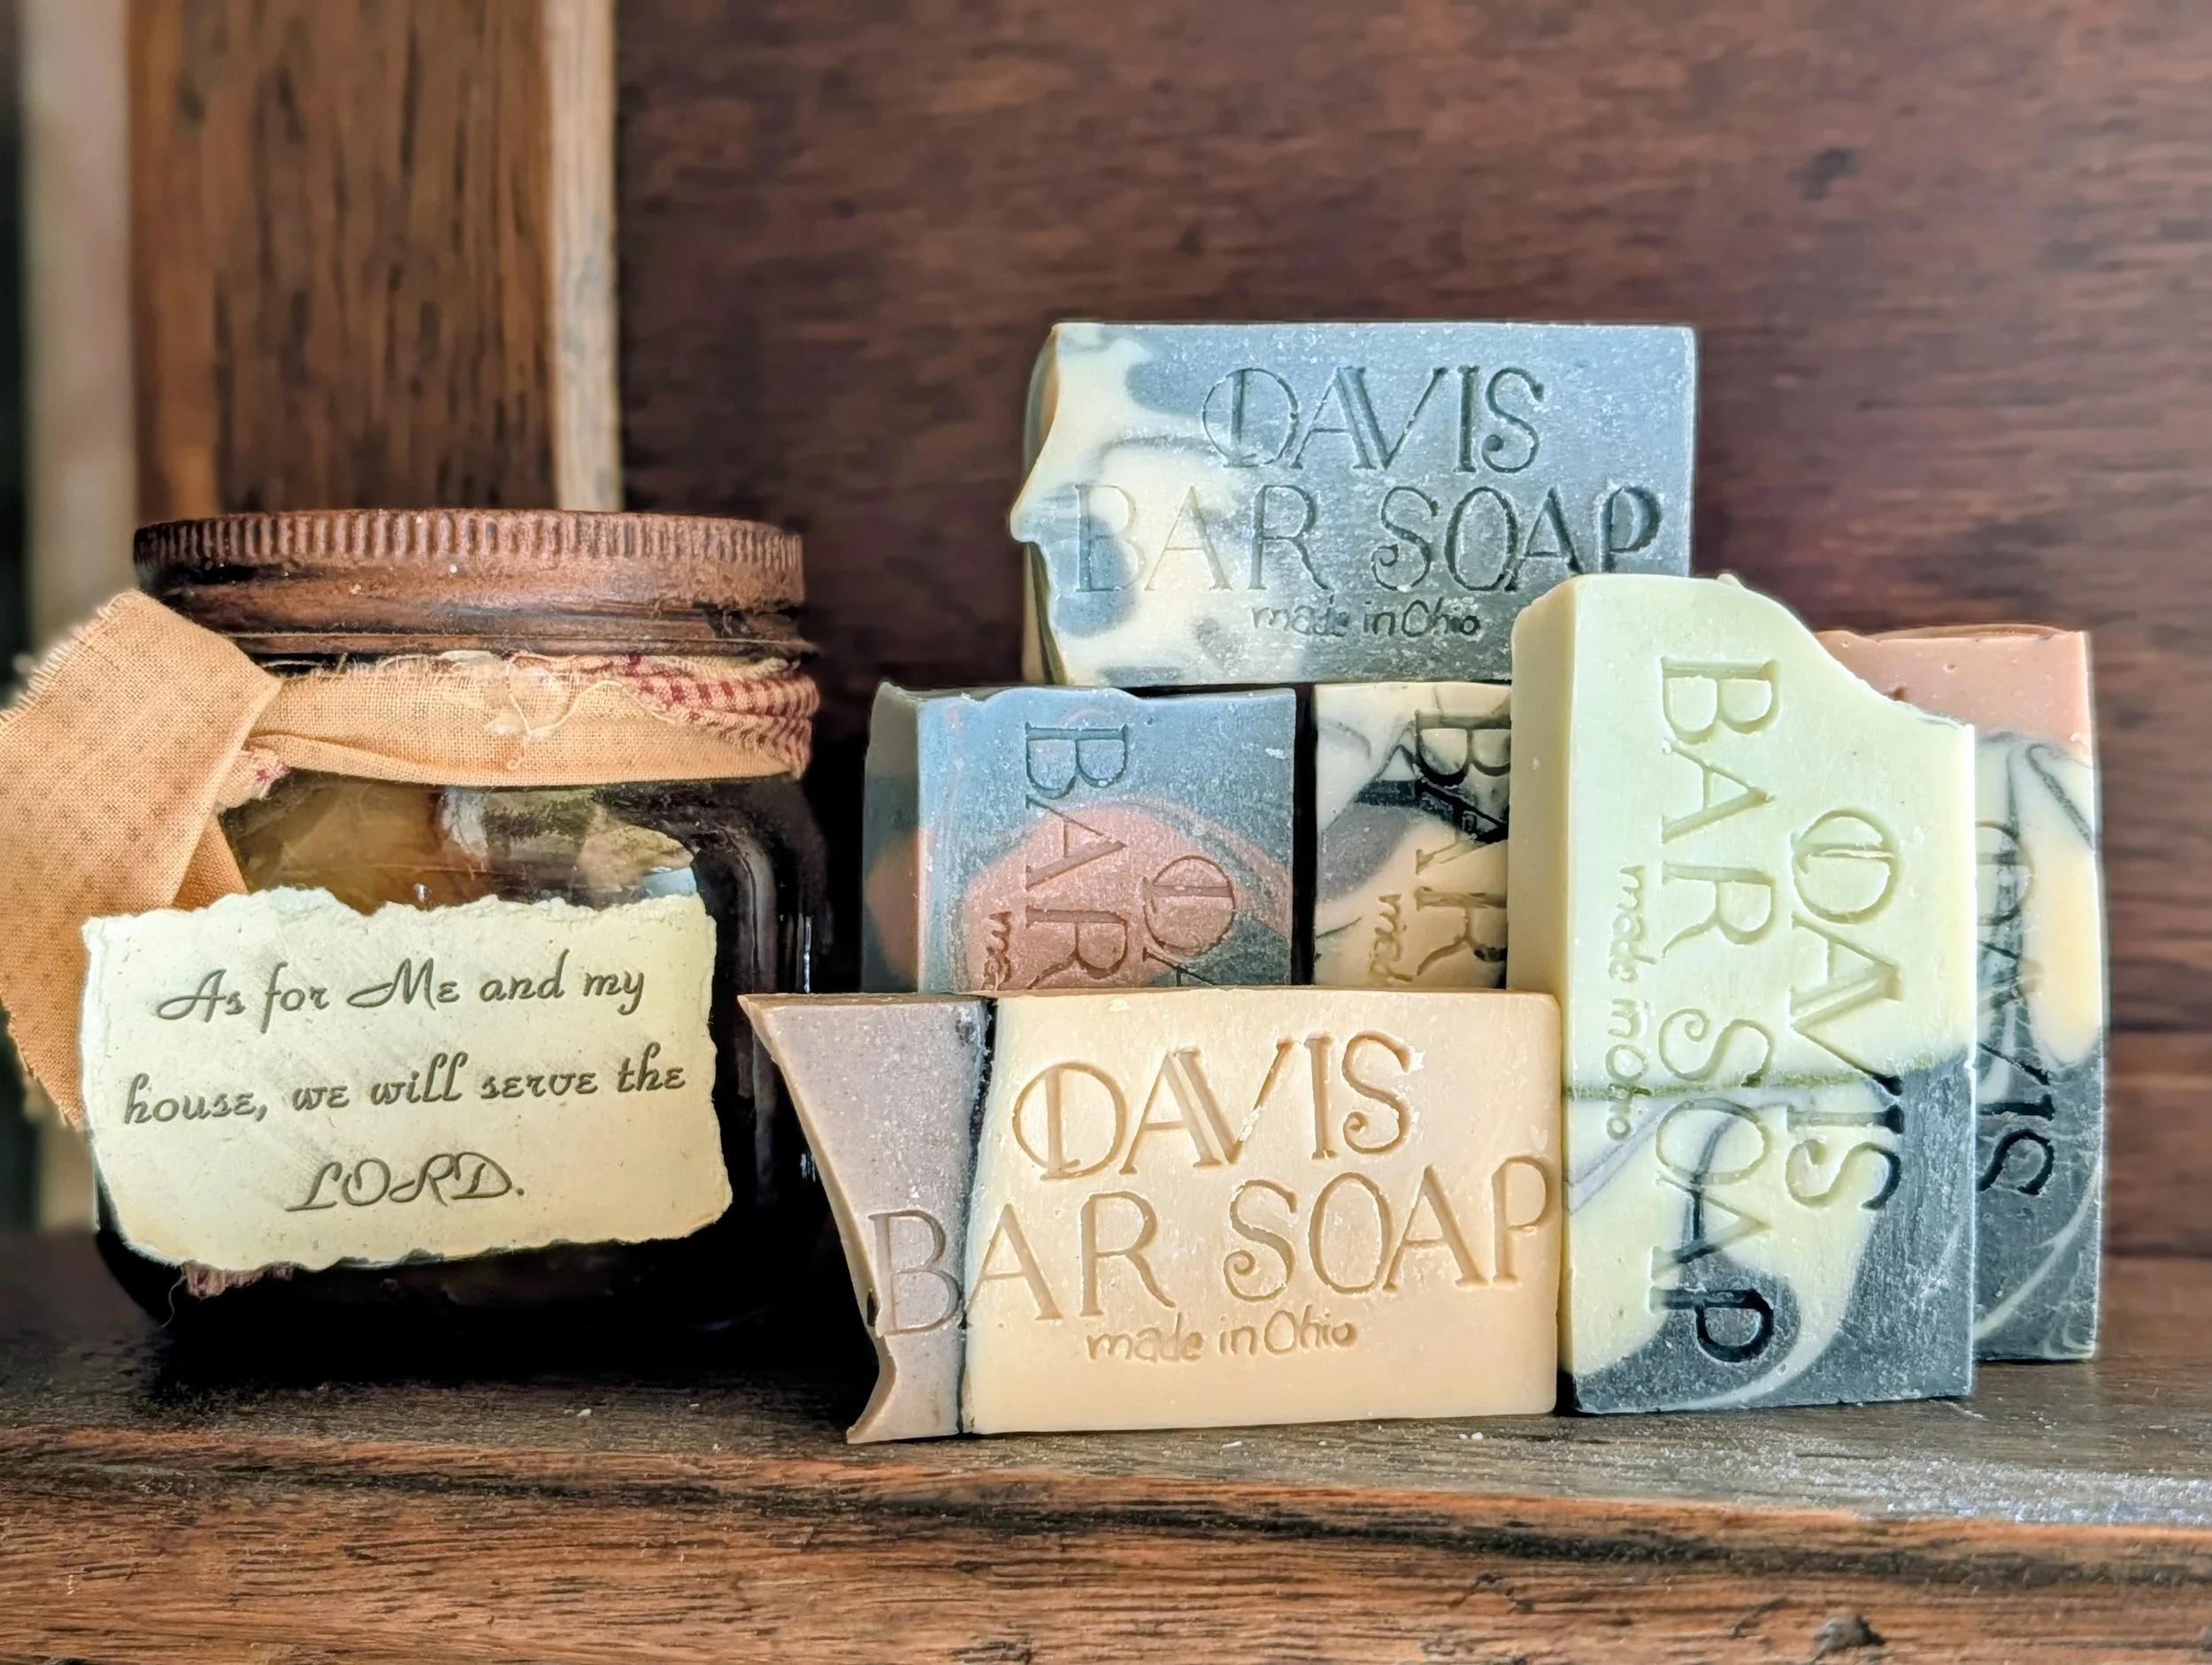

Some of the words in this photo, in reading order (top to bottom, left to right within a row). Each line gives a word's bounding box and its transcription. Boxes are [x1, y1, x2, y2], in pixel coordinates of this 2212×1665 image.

[1202, 366, 1546, 473] DAVIS
[1071, 483, 1334, 594] BAR
[1370, 485, 1663, 593] SOAP
[1248, 595, 1348, 638] made
[1026, 722, 1128, 990] BAR
[1661, 656, 1782, 960] BAR
[157, 968, 243, 1023] As
[261, 961, 332, 1033] for
[347, 957, 460, 1010] Me
[479, 949, 565, 1002] and
[583, 970, 644, 1015] my
[1606, 863, 1657, 999] made
[1786, 809, 1904, 1212] DAVIS
[125, 1072, 267, 1124] house,
[292, 1084, 350, 1111] we
[371, 1051, 470, 1106] will
[480, 1070, 599, 1101] serve
[617, 1042, 686, 1093] the
[1011, 1030, 1416, 1181] DAVIS
[286, 1151, 526, 1212] LORD.
[1649, 1008, 1775, 1363] SOAP
[866, 1190, 1177, 1337] BAR
[1222, 1155, 1555, 1303] SOAP
[1087, 1313, 1205, 1364] made
